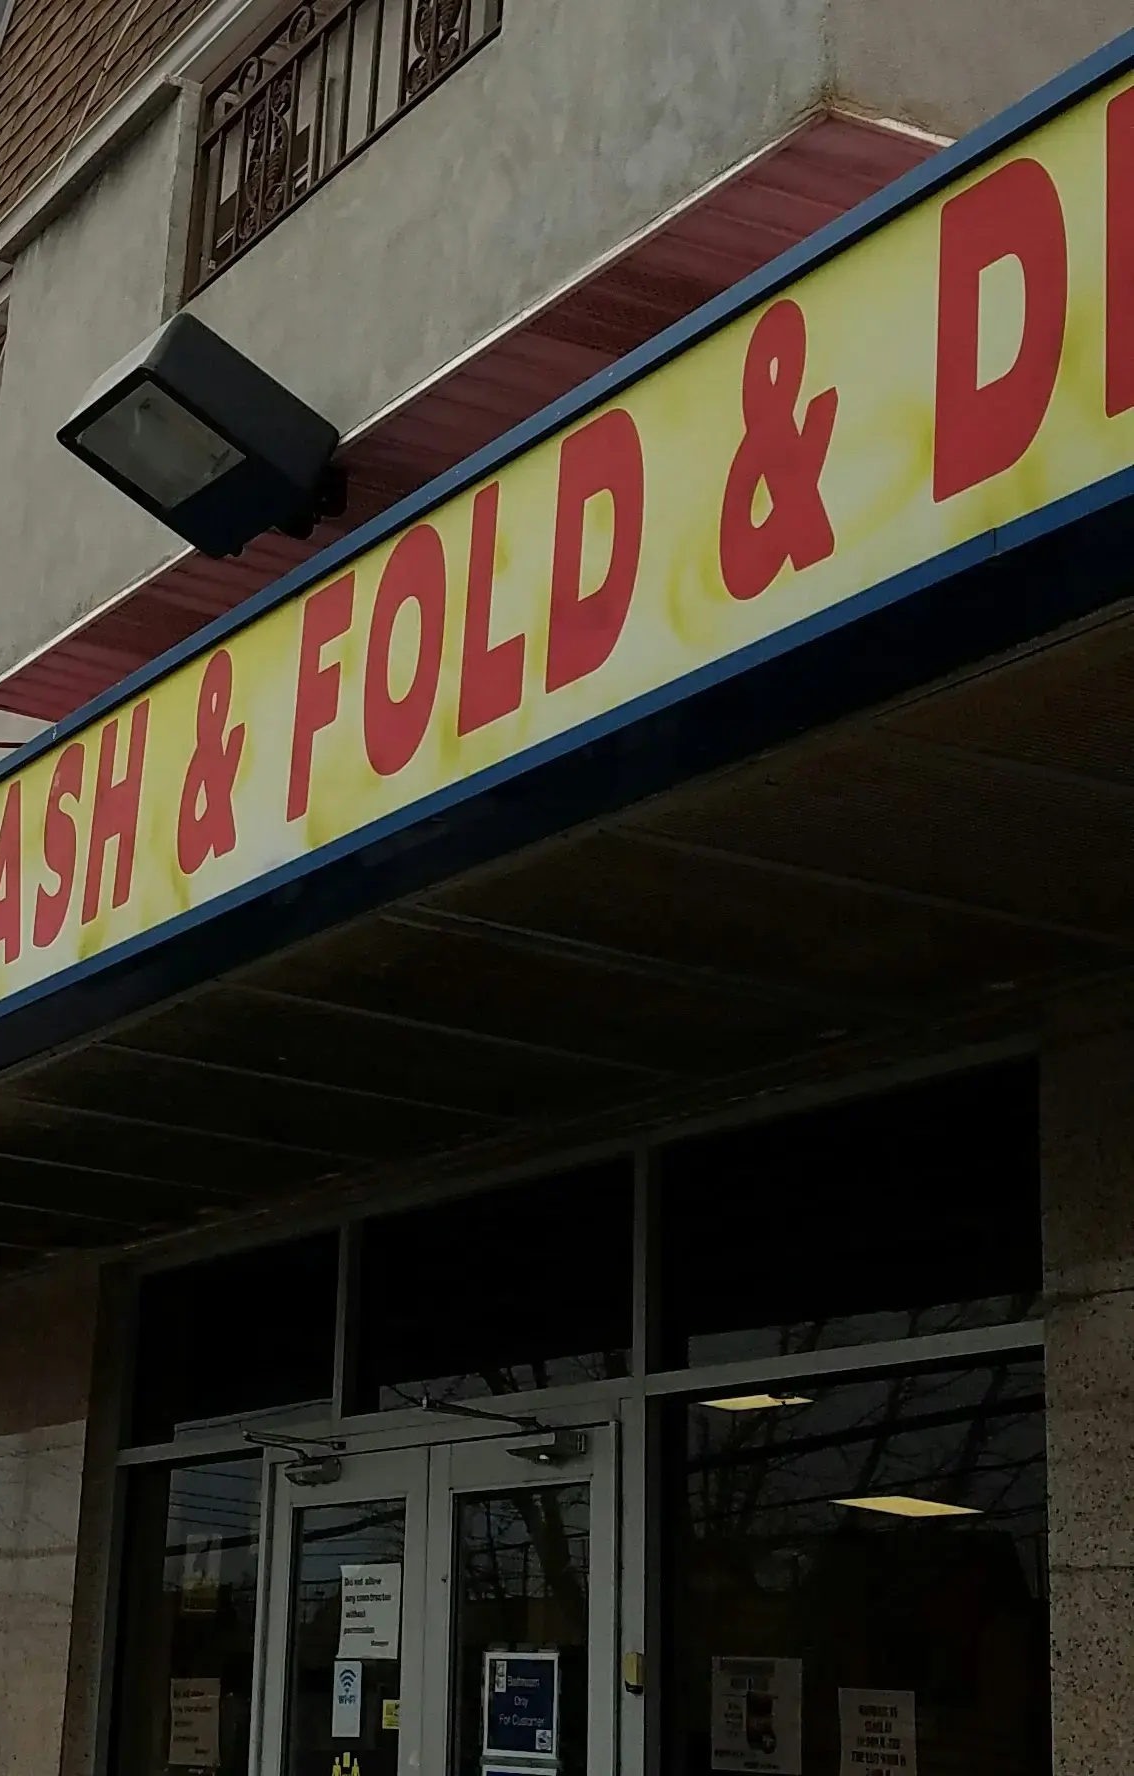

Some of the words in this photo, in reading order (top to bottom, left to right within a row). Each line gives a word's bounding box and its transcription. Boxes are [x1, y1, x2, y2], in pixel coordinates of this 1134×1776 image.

[176, 648, 246, 876] &
[285, 407, 645, 825] FOLD
[719, 298, 840, 601] &
[932, 83, 1134, 505] D
